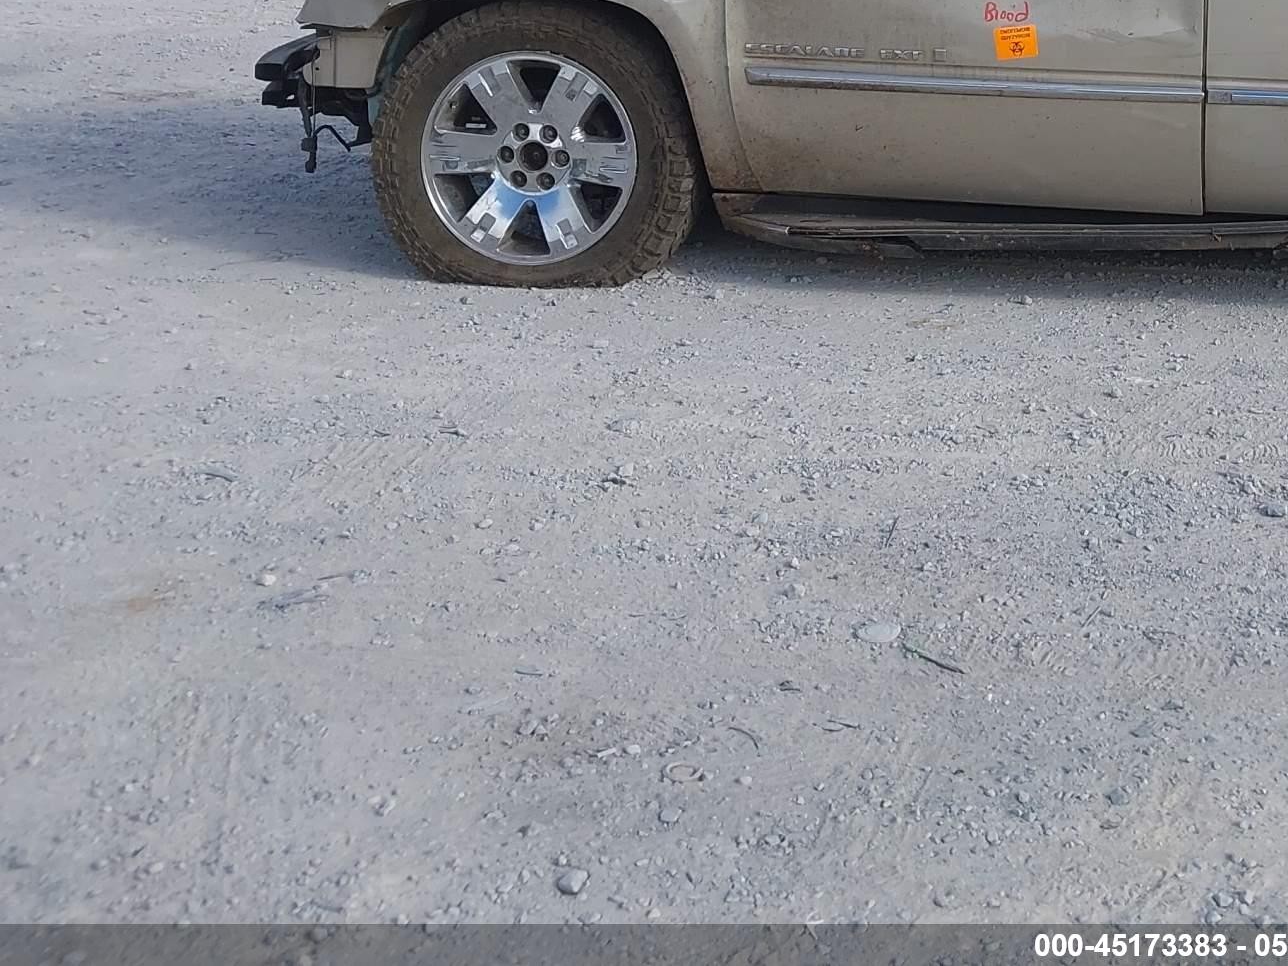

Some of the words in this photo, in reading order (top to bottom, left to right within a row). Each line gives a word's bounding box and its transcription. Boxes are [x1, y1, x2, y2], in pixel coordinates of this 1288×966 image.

[984, 1, 1029, 22] Blood
[745, 42, 865, 58] ESCALADE
[879, 48, 924, 60] EXT
